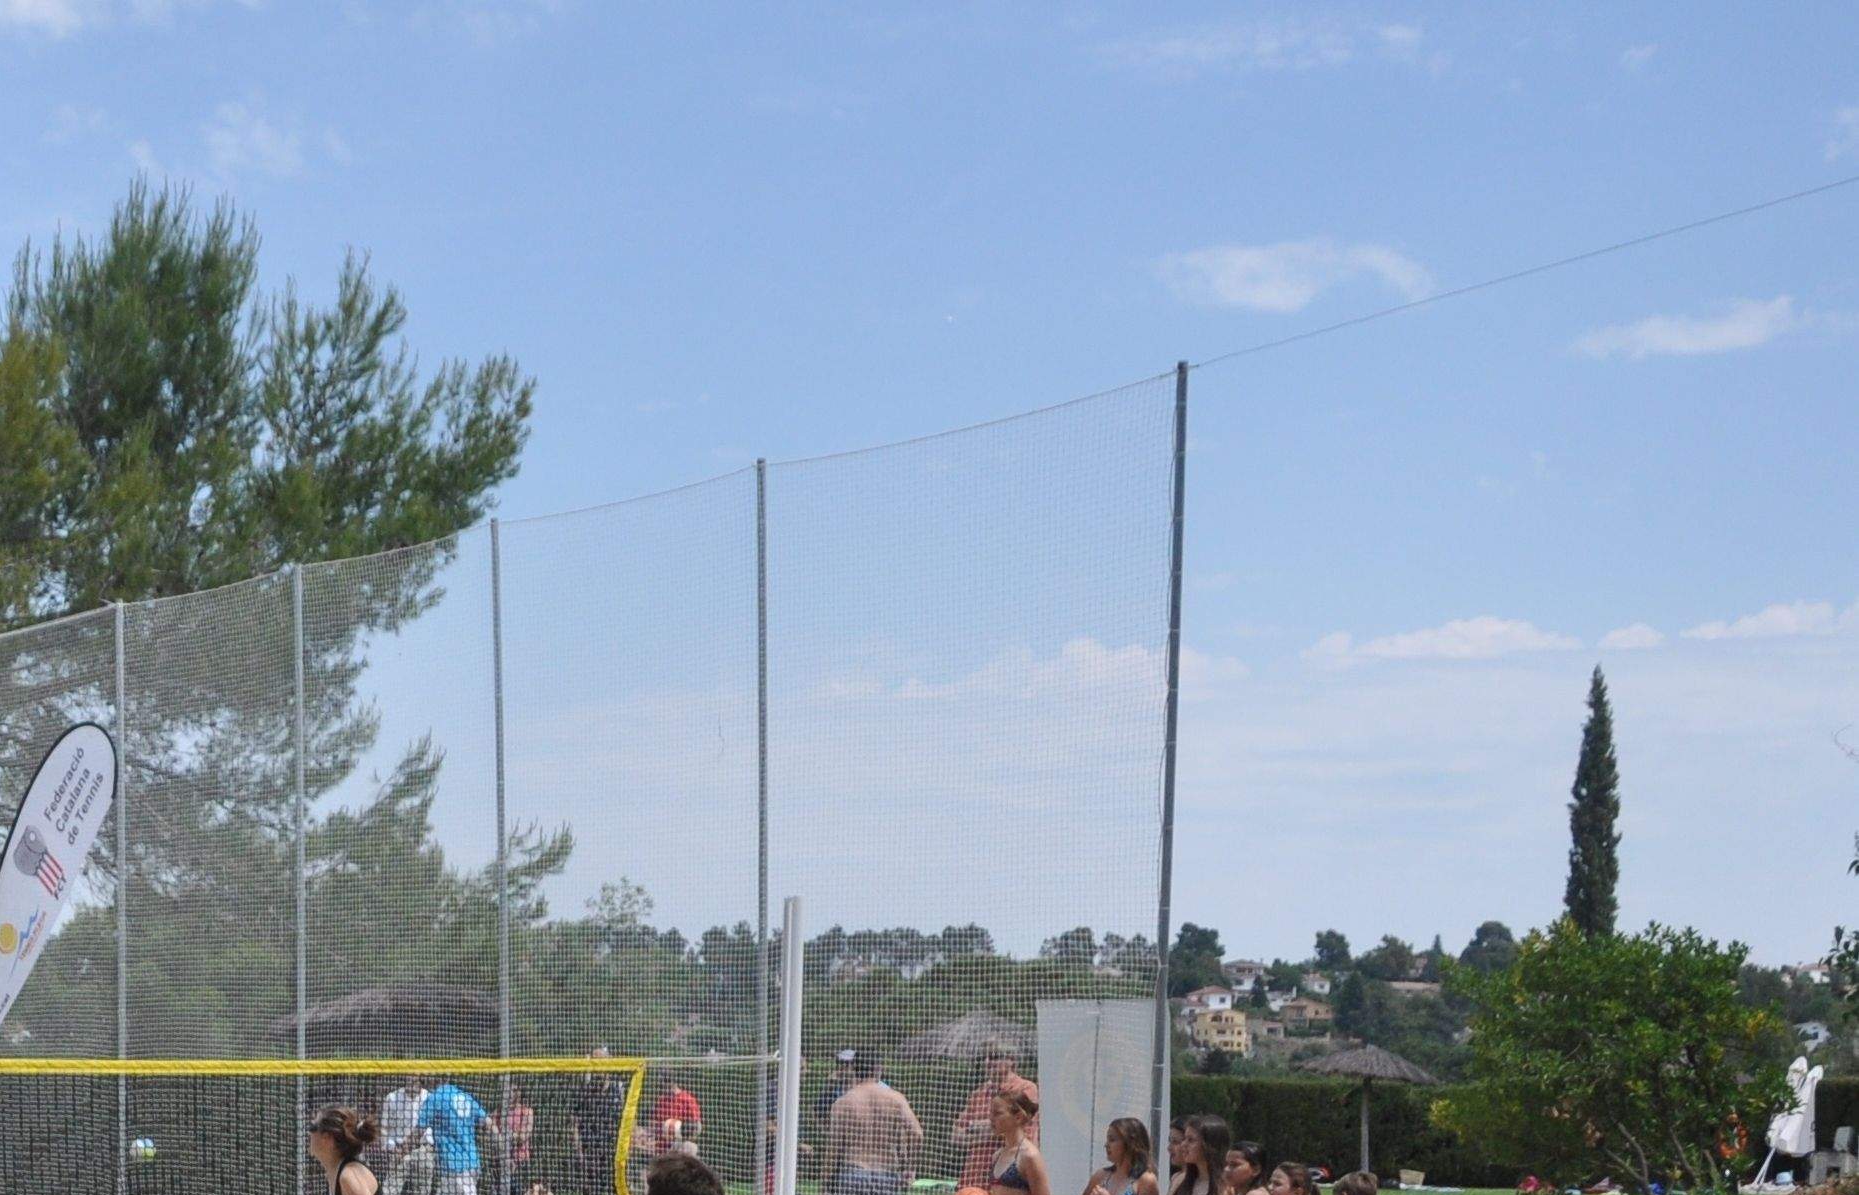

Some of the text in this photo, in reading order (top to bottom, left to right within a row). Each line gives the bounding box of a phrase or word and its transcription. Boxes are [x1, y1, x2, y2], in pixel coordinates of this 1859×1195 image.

[44, 747, 84, 821] Federació
[55, 768, 91, 832] Catalana
[68, 772, 104, 845] de Tennis
